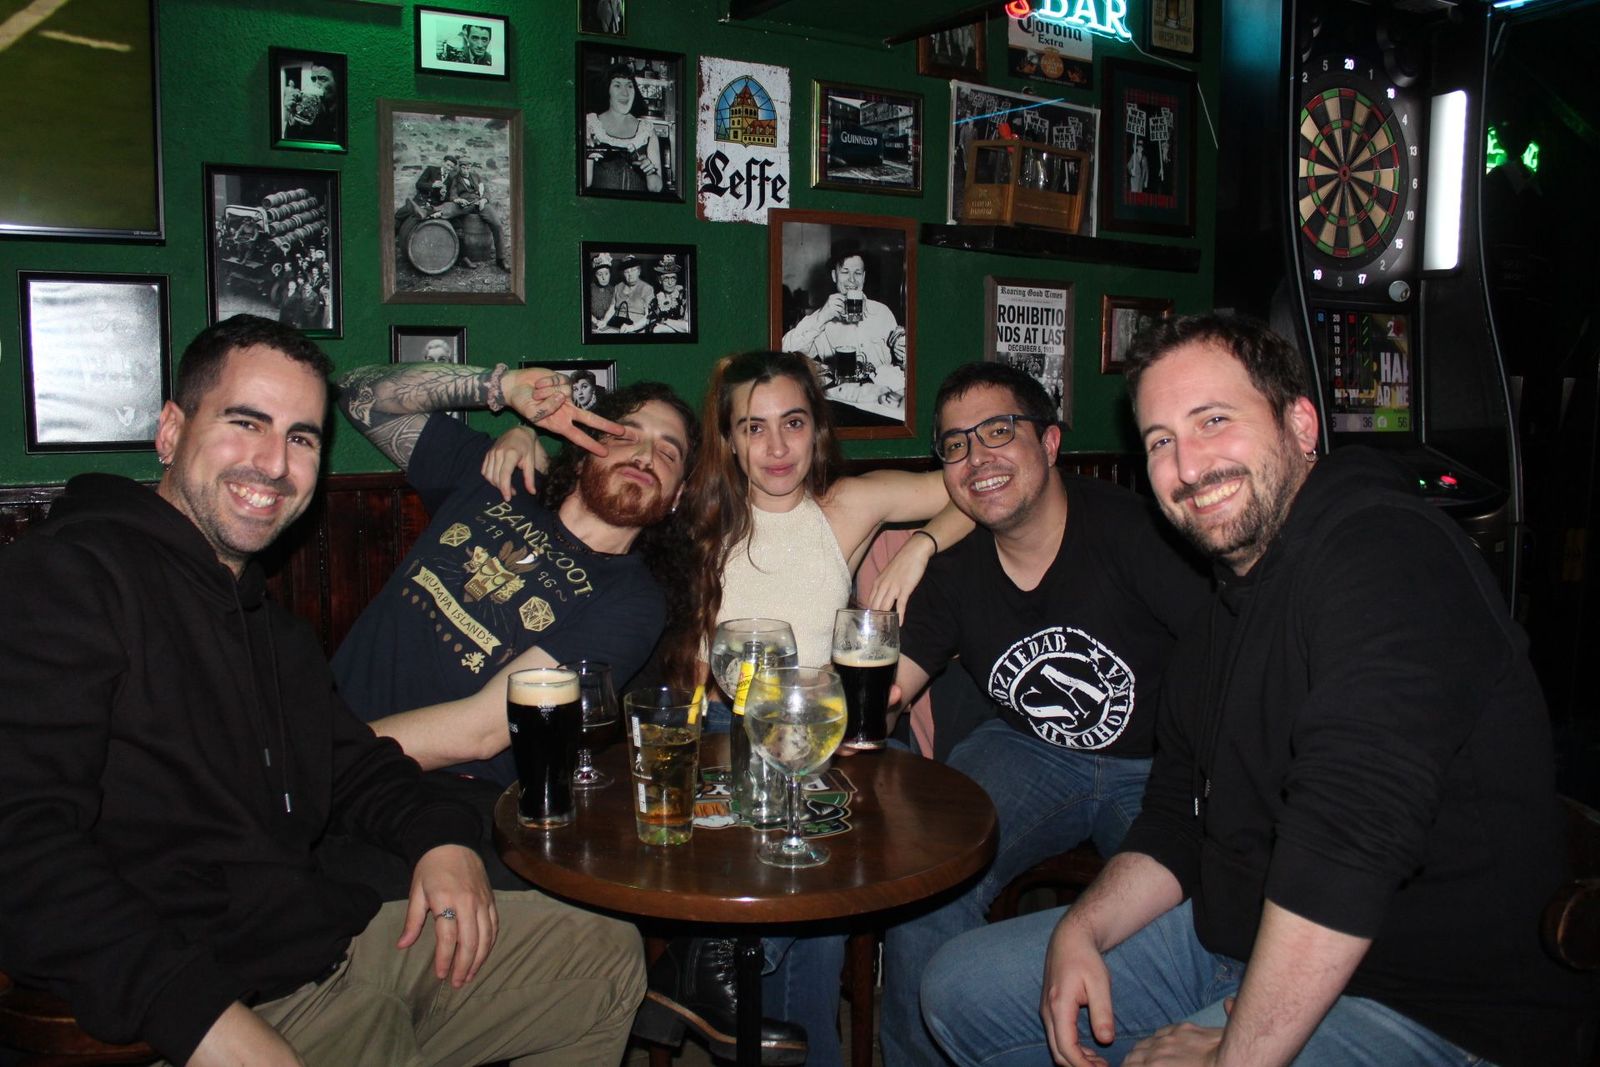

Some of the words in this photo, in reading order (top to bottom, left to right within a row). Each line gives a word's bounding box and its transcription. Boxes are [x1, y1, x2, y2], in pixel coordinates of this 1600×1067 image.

[1018, 15, 1082, 41] Corona
[1038, 36, 1064, 48] Extra
[1322, 60, 1329, 71] 5
[1344, 58, 1354, 70] 20
[1369, 69, 1374, 80] 1
[1387, 88, 1396, 99] 18
[1402, 114, 1408, 126] 4
[841, 131, 873, 146] GUINNESS
[1409, 146, 1418, 157] 13
[700, 150, 787, 211] Leffe
[1412, 178, 1418, 189] 6
[1406, 210, 1415, 221] 10
[1394, 238, 1404, 249] 15
[1380, 260, 1386, 271] 2
[1313, 269, 1322, 281] 19
[1358, 273, 1367, 284] 17
[1337, 276, 1343, 287] 3
[1000, 286, 1026, 297] Roaring
[1027, 289, 1043, 297] Good
[1045, 290, 1063, 299] Times
[998, 304, 1066, 327] ROHIBITIO
[1024, 327, 1039, 344] AT
[1008, 344, 1037, 353] DECEMBER
[485, 525, 504, 540] 19
[538, 571, 557, 588] 96
[422, 573, 453, 610] WUMPA
[451, 609, 493, 645] ISLANDS
